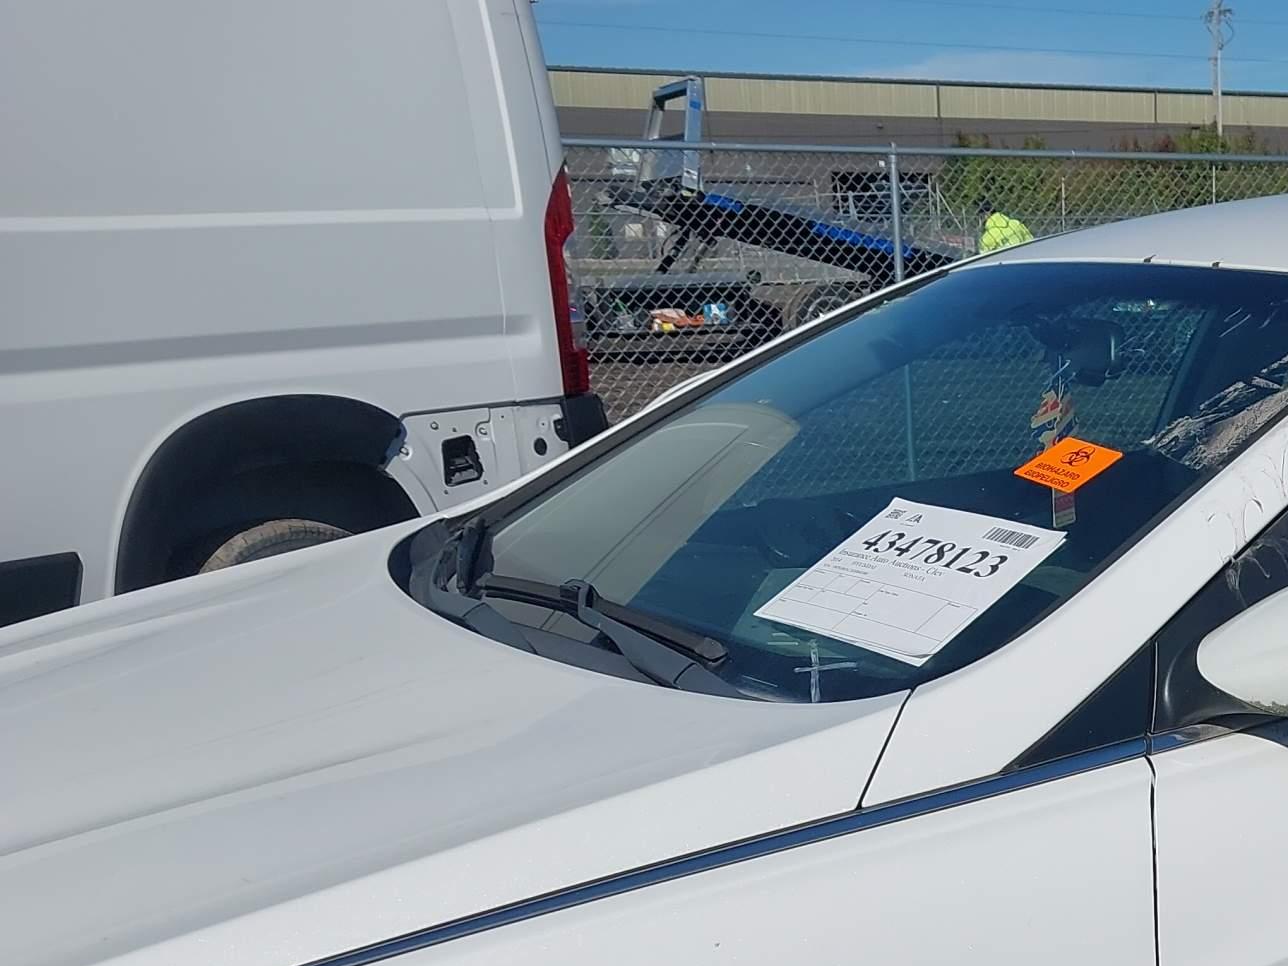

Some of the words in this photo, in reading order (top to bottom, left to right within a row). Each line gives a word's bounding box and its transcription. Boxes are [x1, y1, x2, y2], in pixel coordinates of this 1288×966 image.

[1023, 469, 1070, 488] BIOPELIGRO
[1034, 462, 1081, 480] BIOHAZARD
[862, 529, 1008, 578] 43478123
